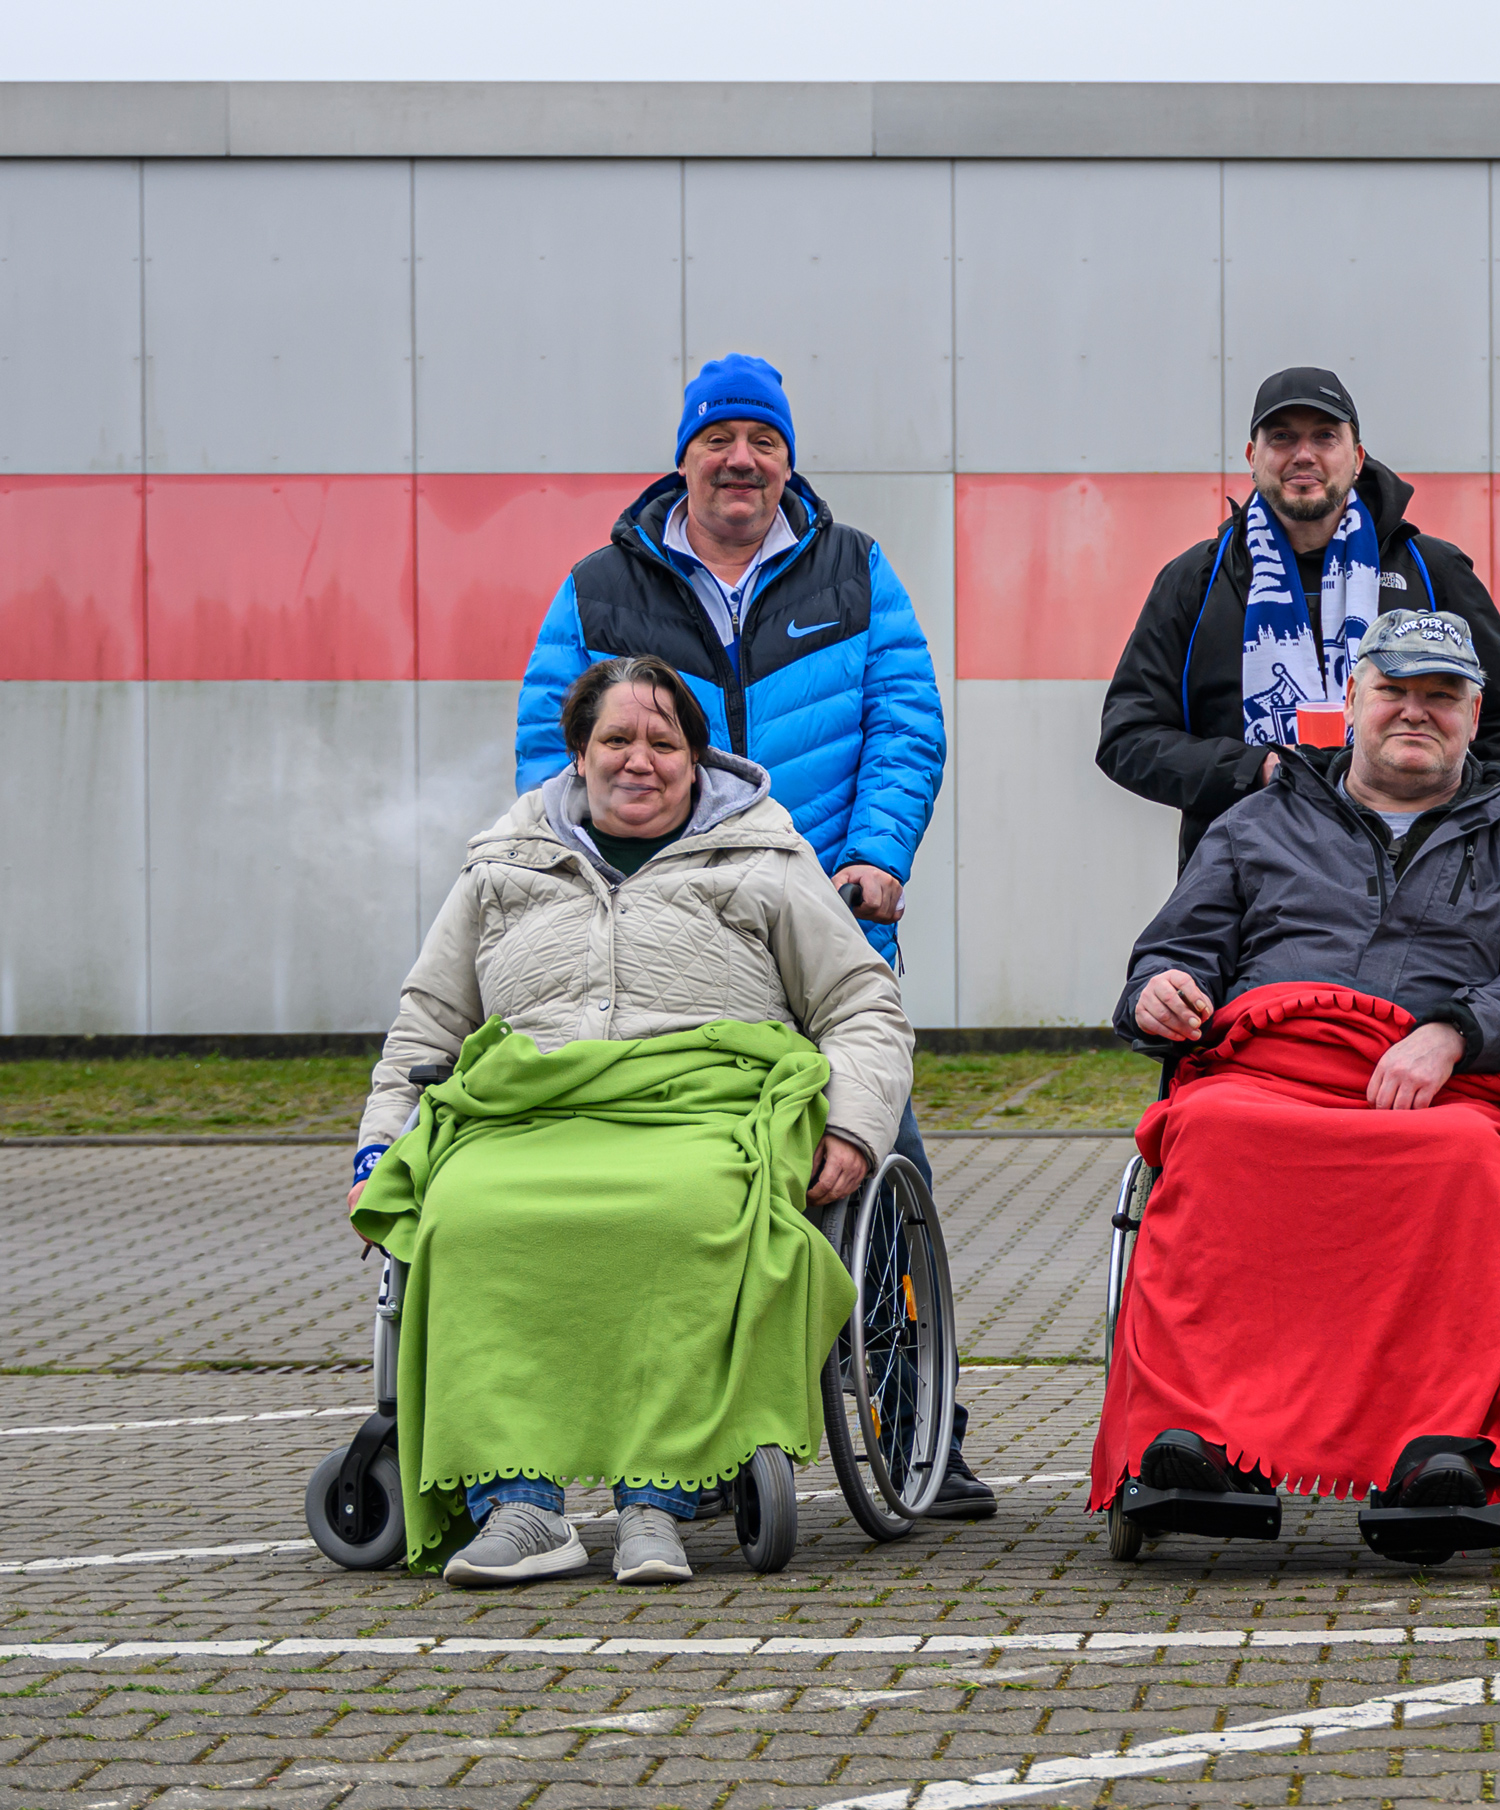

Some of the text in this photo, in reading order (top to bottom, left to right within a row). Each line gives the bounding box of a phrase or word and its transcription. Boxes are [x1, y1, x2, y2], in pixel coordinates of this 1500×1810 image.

[725, 397, 775, 412] MAGDEBURG
[1394, 620, 1420, 638] NUR
[1419, 617, 1443, 631] DER
[1421, 630, 1445, 641] 1965
